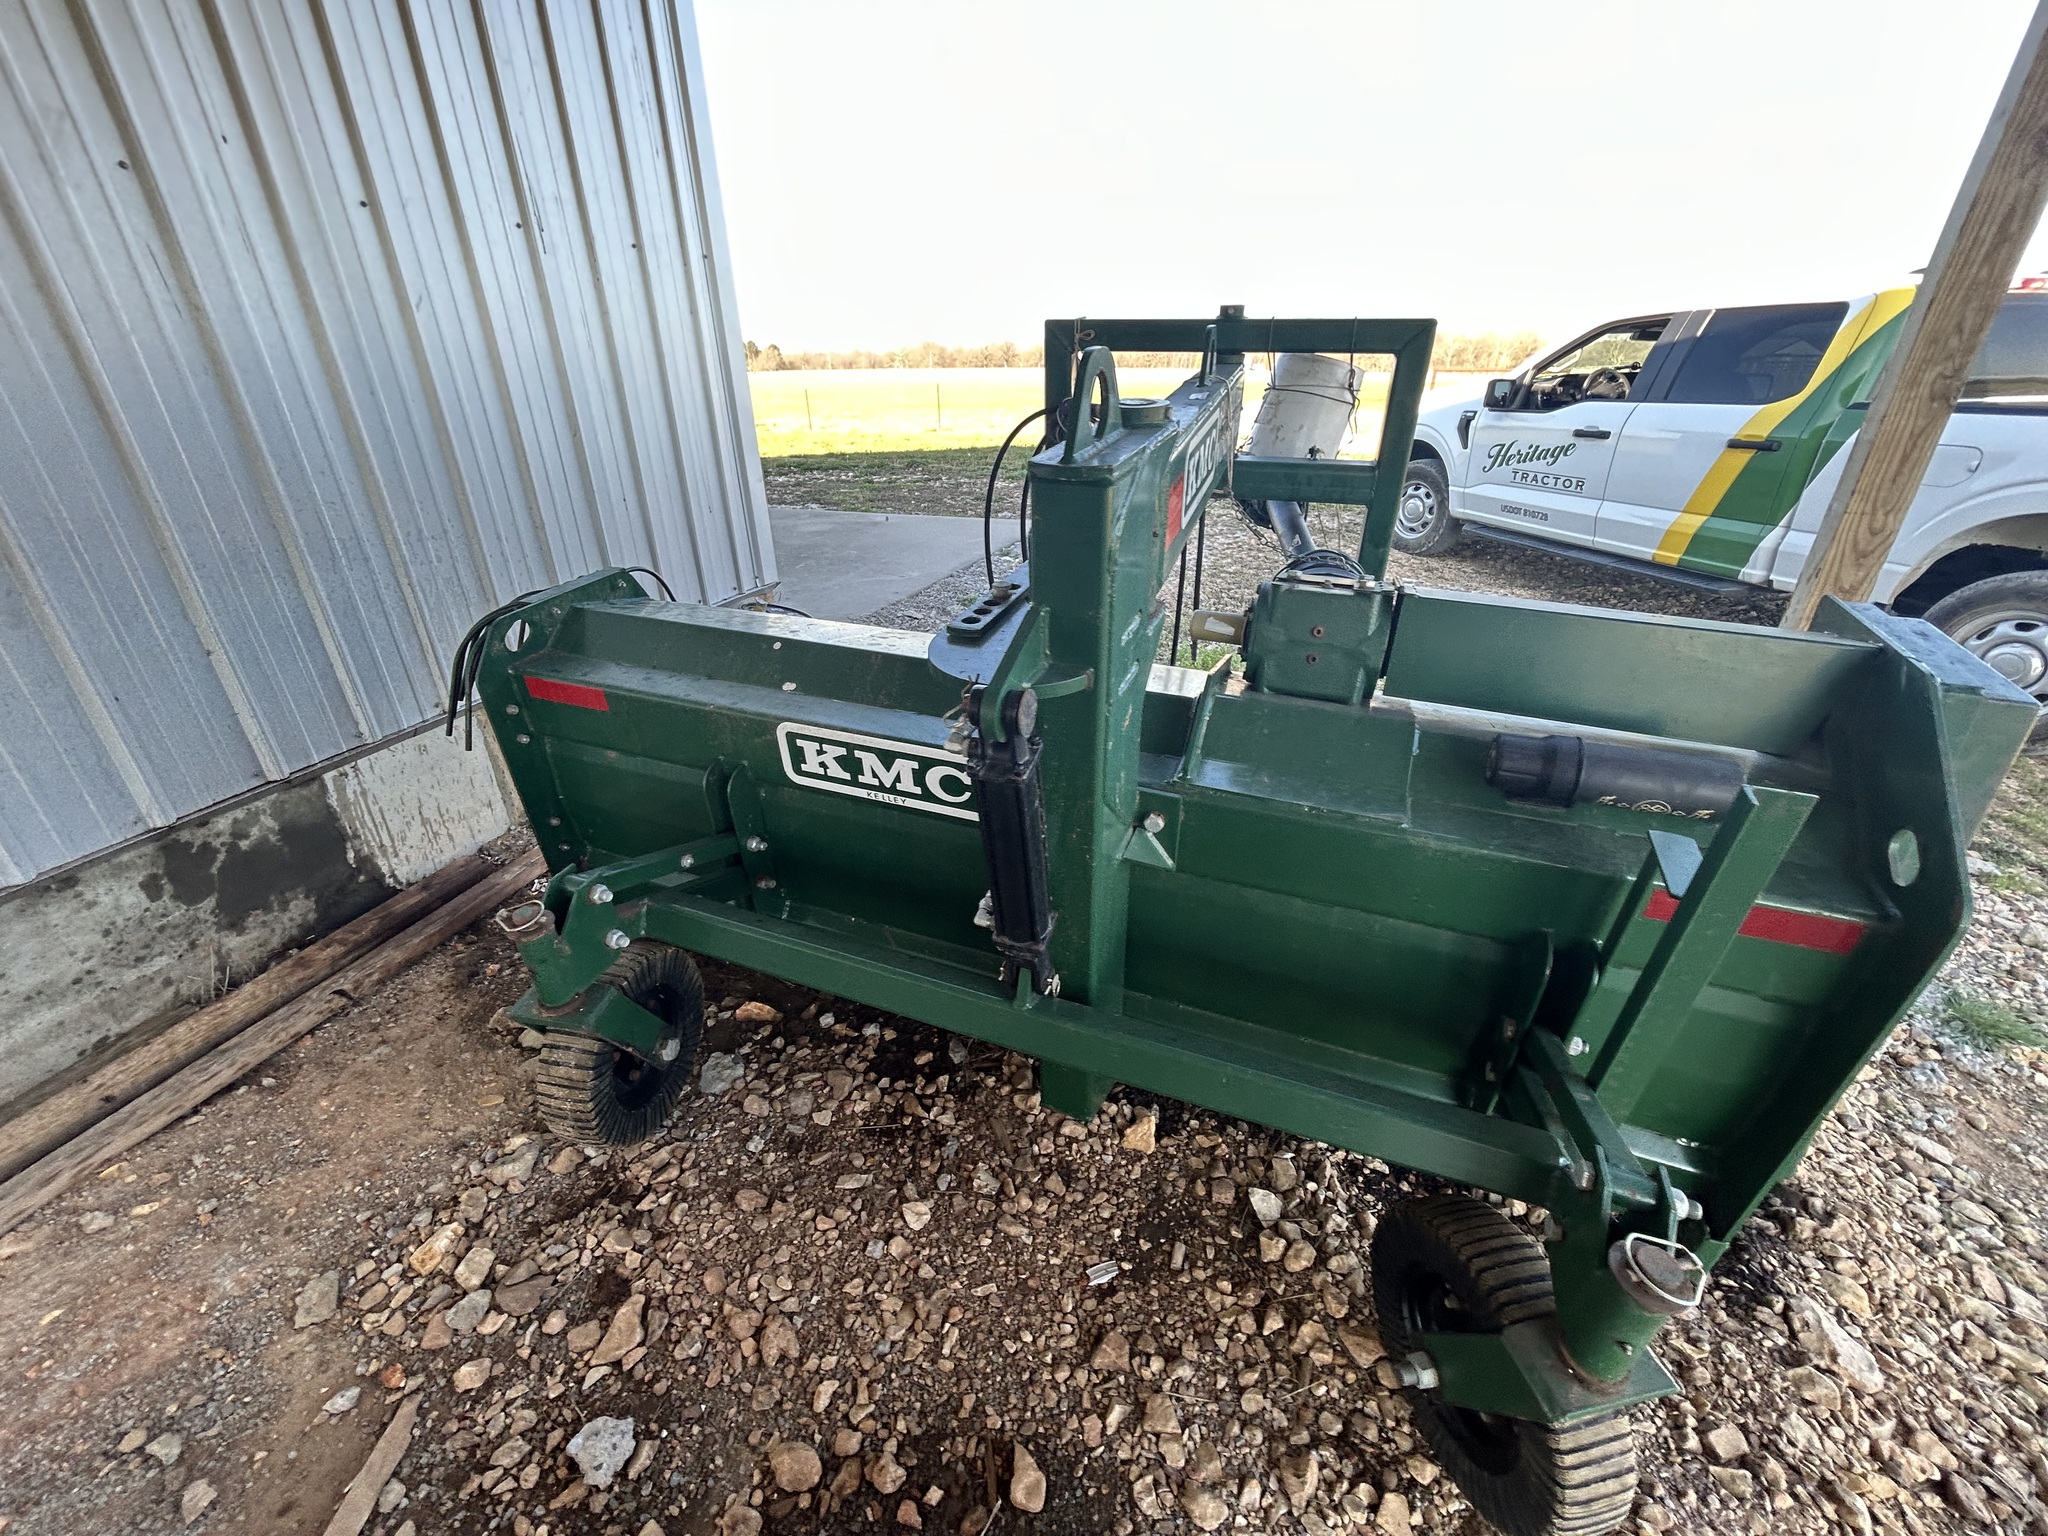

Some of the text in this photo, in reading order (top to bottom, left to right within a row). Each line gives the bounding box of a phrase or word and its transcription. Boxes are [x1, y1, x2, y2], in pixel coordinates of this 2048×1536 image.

[1482, 440, 1577, 473] Heritage
[1511, 470, 1586, 491] TRACTOR
[1500, 504, 1522, 516] USDOT
[795, 738, 972, 803] KMC
[866, 791, 907, 805] KELLEY
